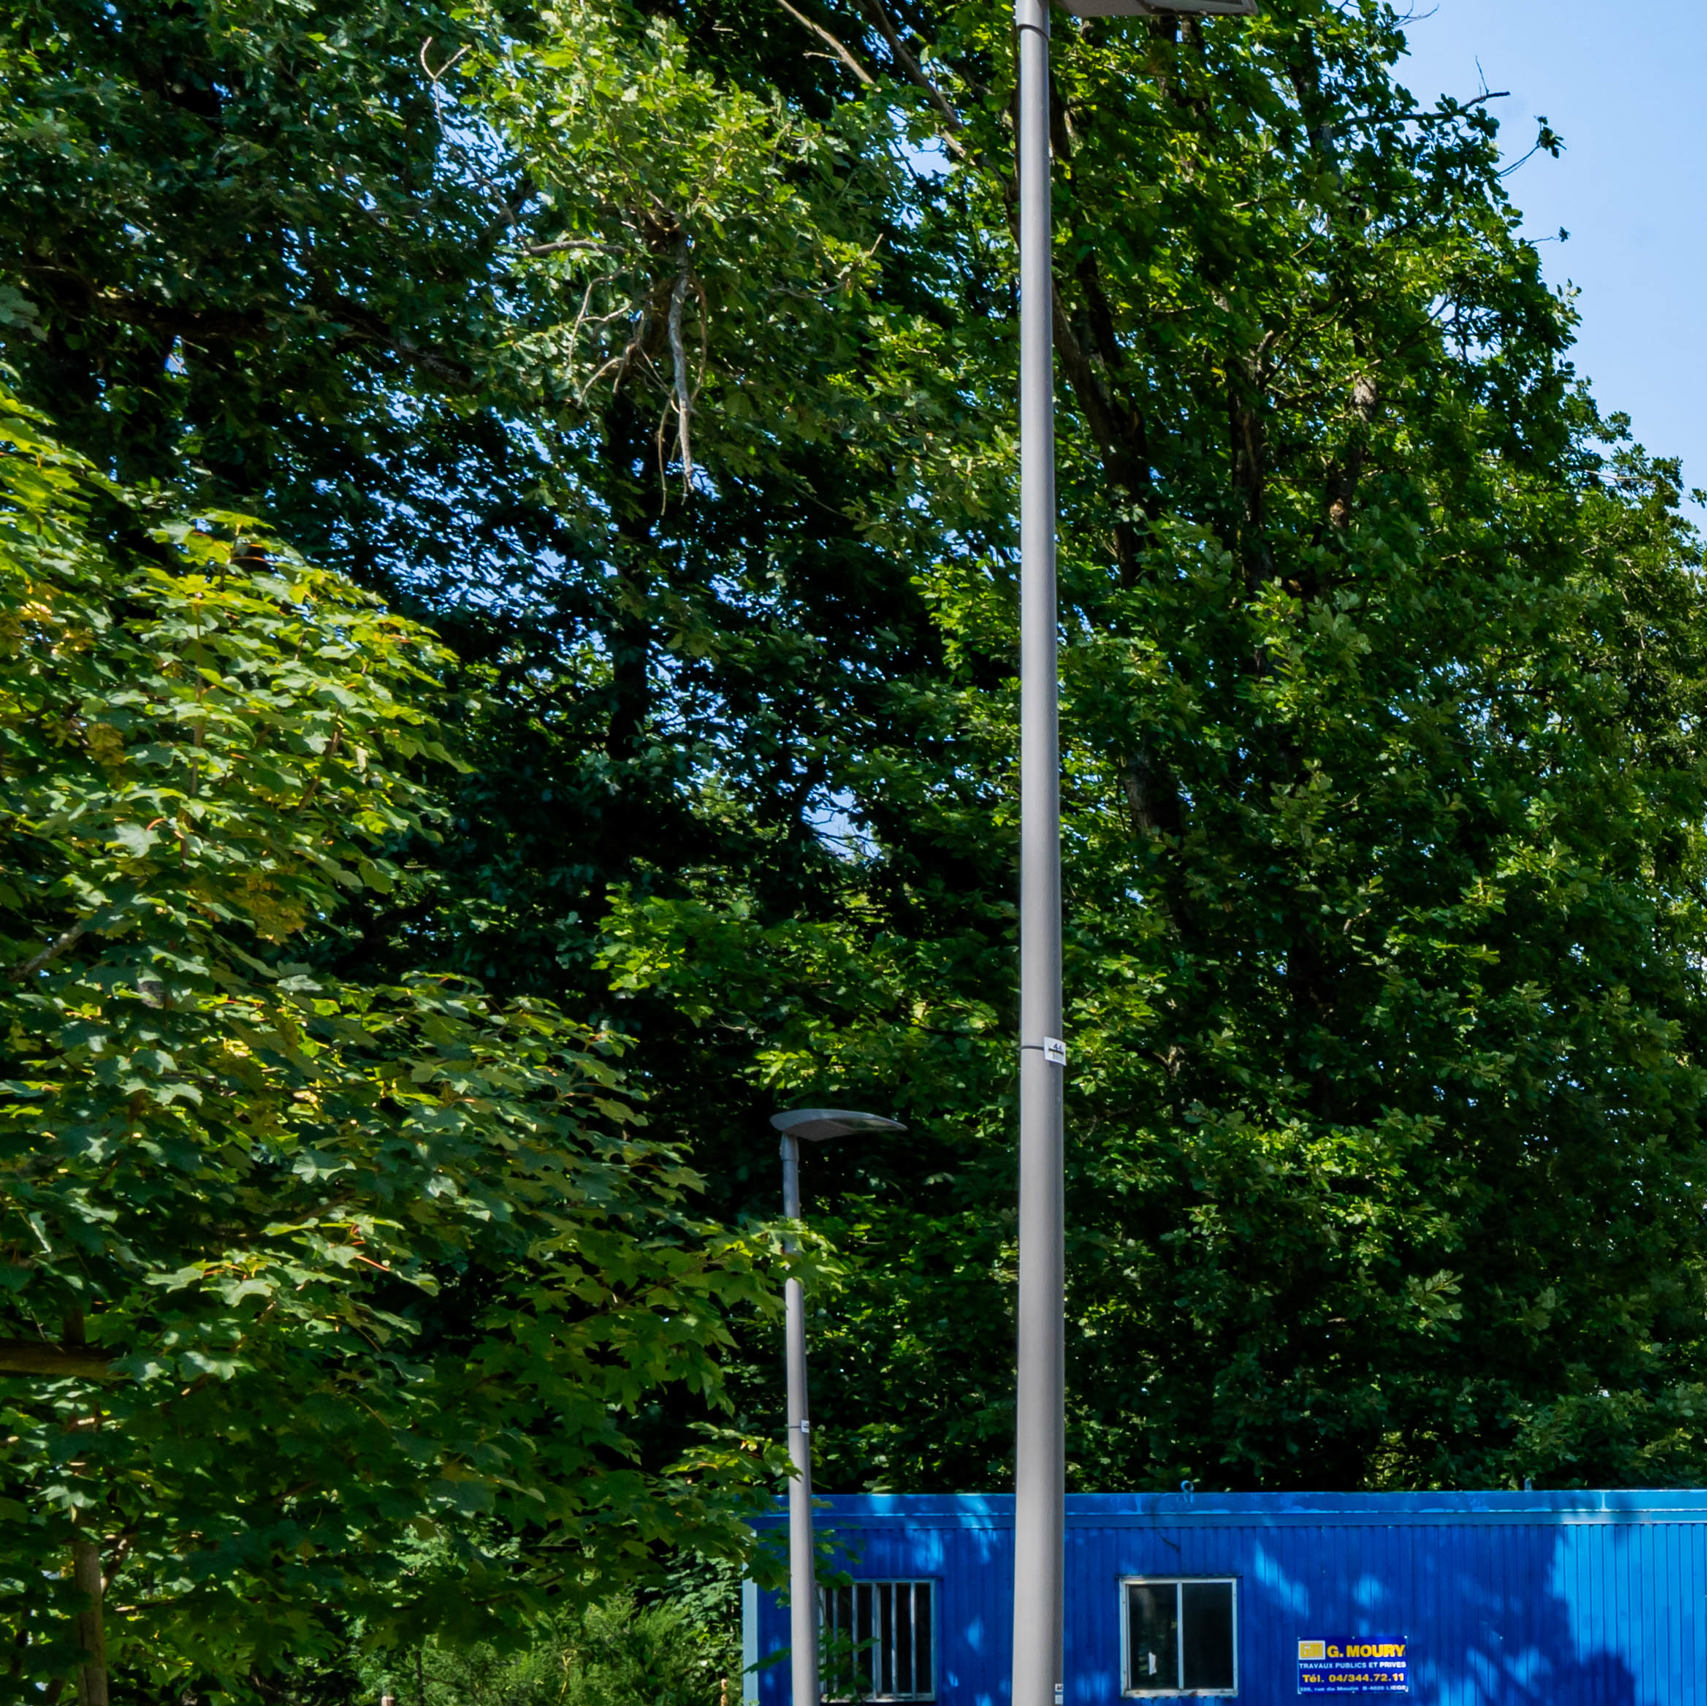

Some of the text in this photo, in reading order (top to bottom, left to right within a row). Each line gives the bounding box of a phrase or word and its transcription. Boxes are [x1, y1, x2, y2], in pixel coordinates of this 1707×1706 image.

[1326, 1644, 1406, 1658] G. MOURY
[1302, 1673, 1405, 1683] Tél. 04/344.72.11
